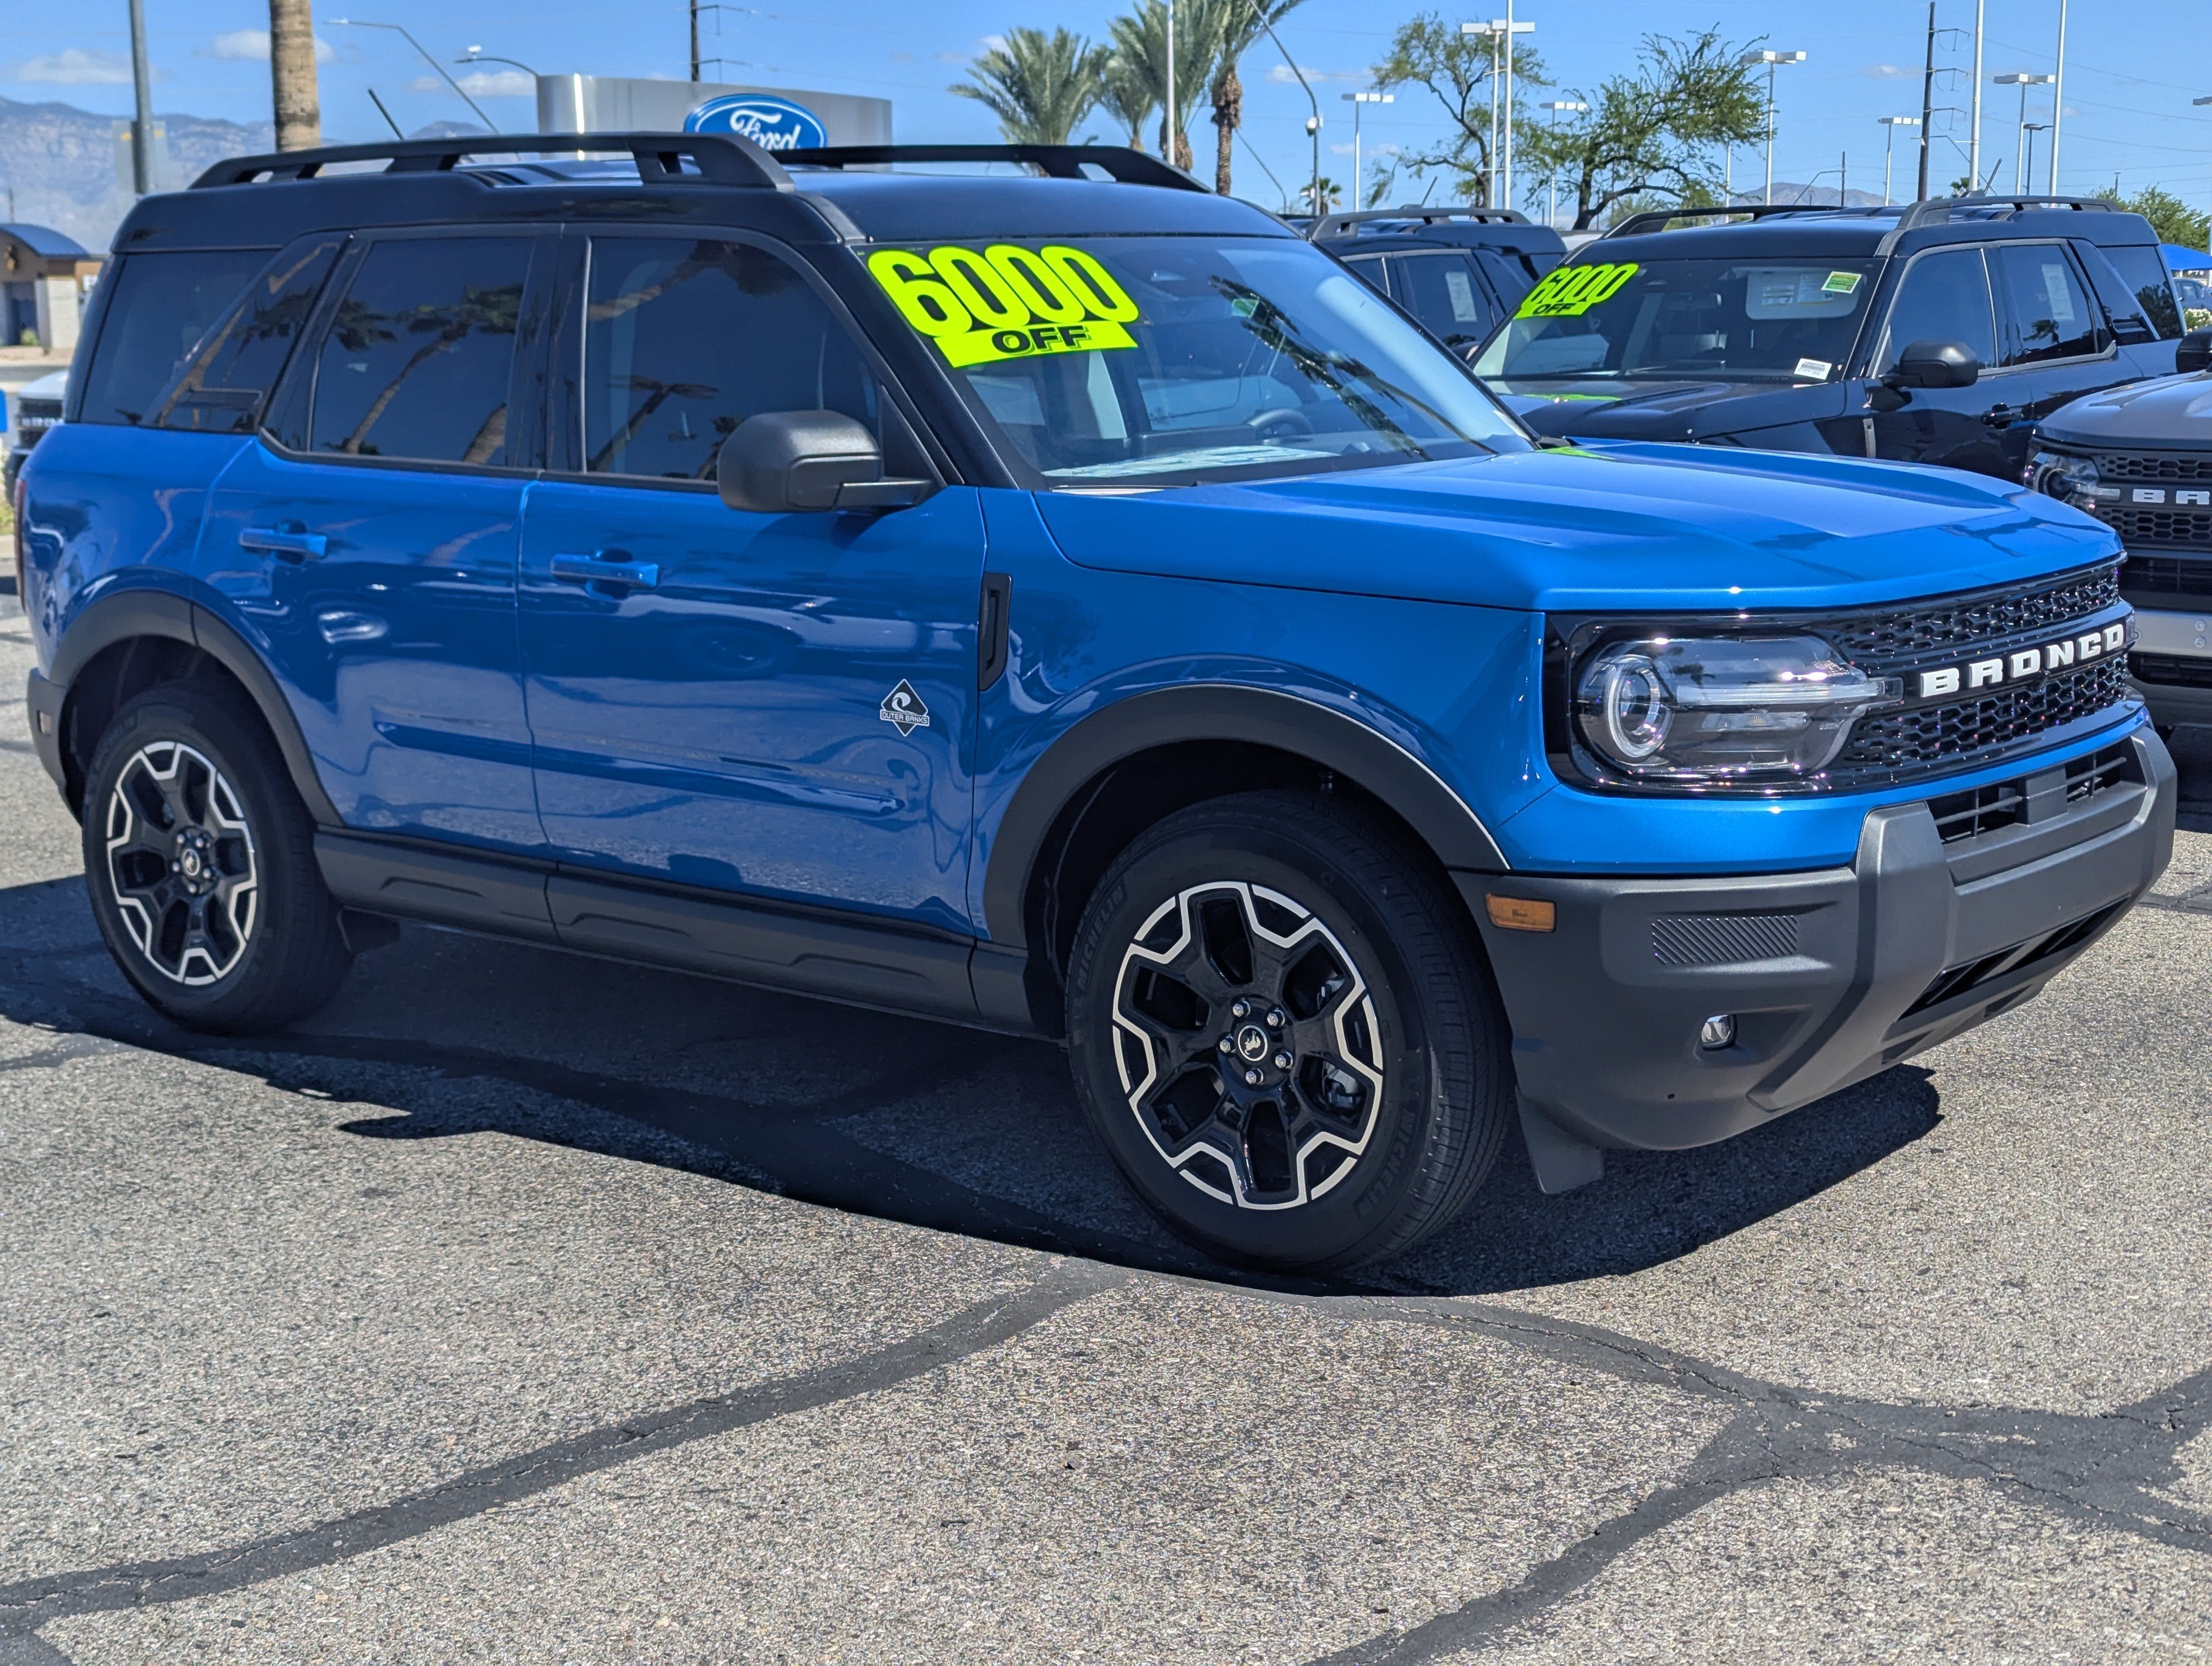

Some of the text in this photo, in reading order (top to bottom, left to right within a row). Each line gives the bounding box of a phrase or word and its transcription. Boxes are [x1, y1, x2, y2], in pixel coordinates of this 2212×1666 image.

[867, 244, 1139, 337] 6000
[1521, 263, 1639, 306] 6000
[1532, 303, 1577, 315] OFF
[992, 325, 1091, 354] OFF
[1920, 624, 2124, 699] BRONCO
[882, 712, 928, 724] OUTER BANKS
[1077, 885, 1124, 991] MICHELIN
